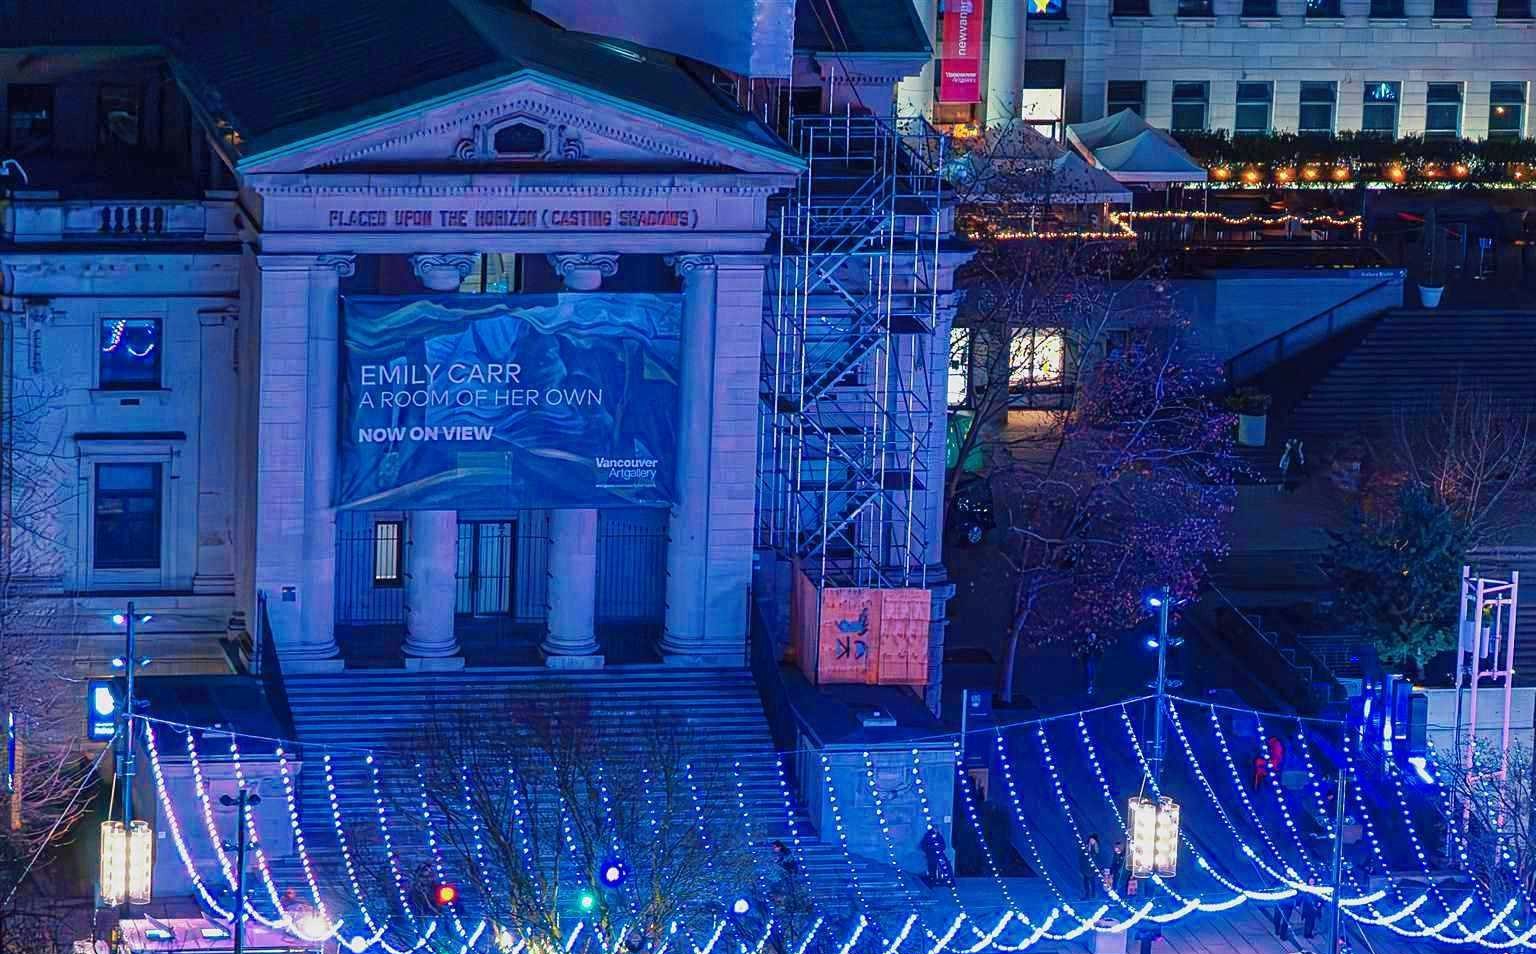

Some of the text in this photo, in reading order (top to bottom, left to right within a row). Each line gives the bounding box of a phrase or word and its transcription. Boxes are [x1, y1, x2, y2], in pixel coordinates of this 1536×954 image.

[328, 209, 387, 227] PLACED
[395, 209, 432, 226] UPON
[439, 209, 468, 227] THE
[475, 209, 537, 227] HORIZON
[361, 363, 521, 385] EMILY CARR
[359, 388, 603, 408] A ROOM OF HER OWN
[358, 425, 493, 442] NOW ON VIEW
[595, 457, 658, 468] Vancouver
